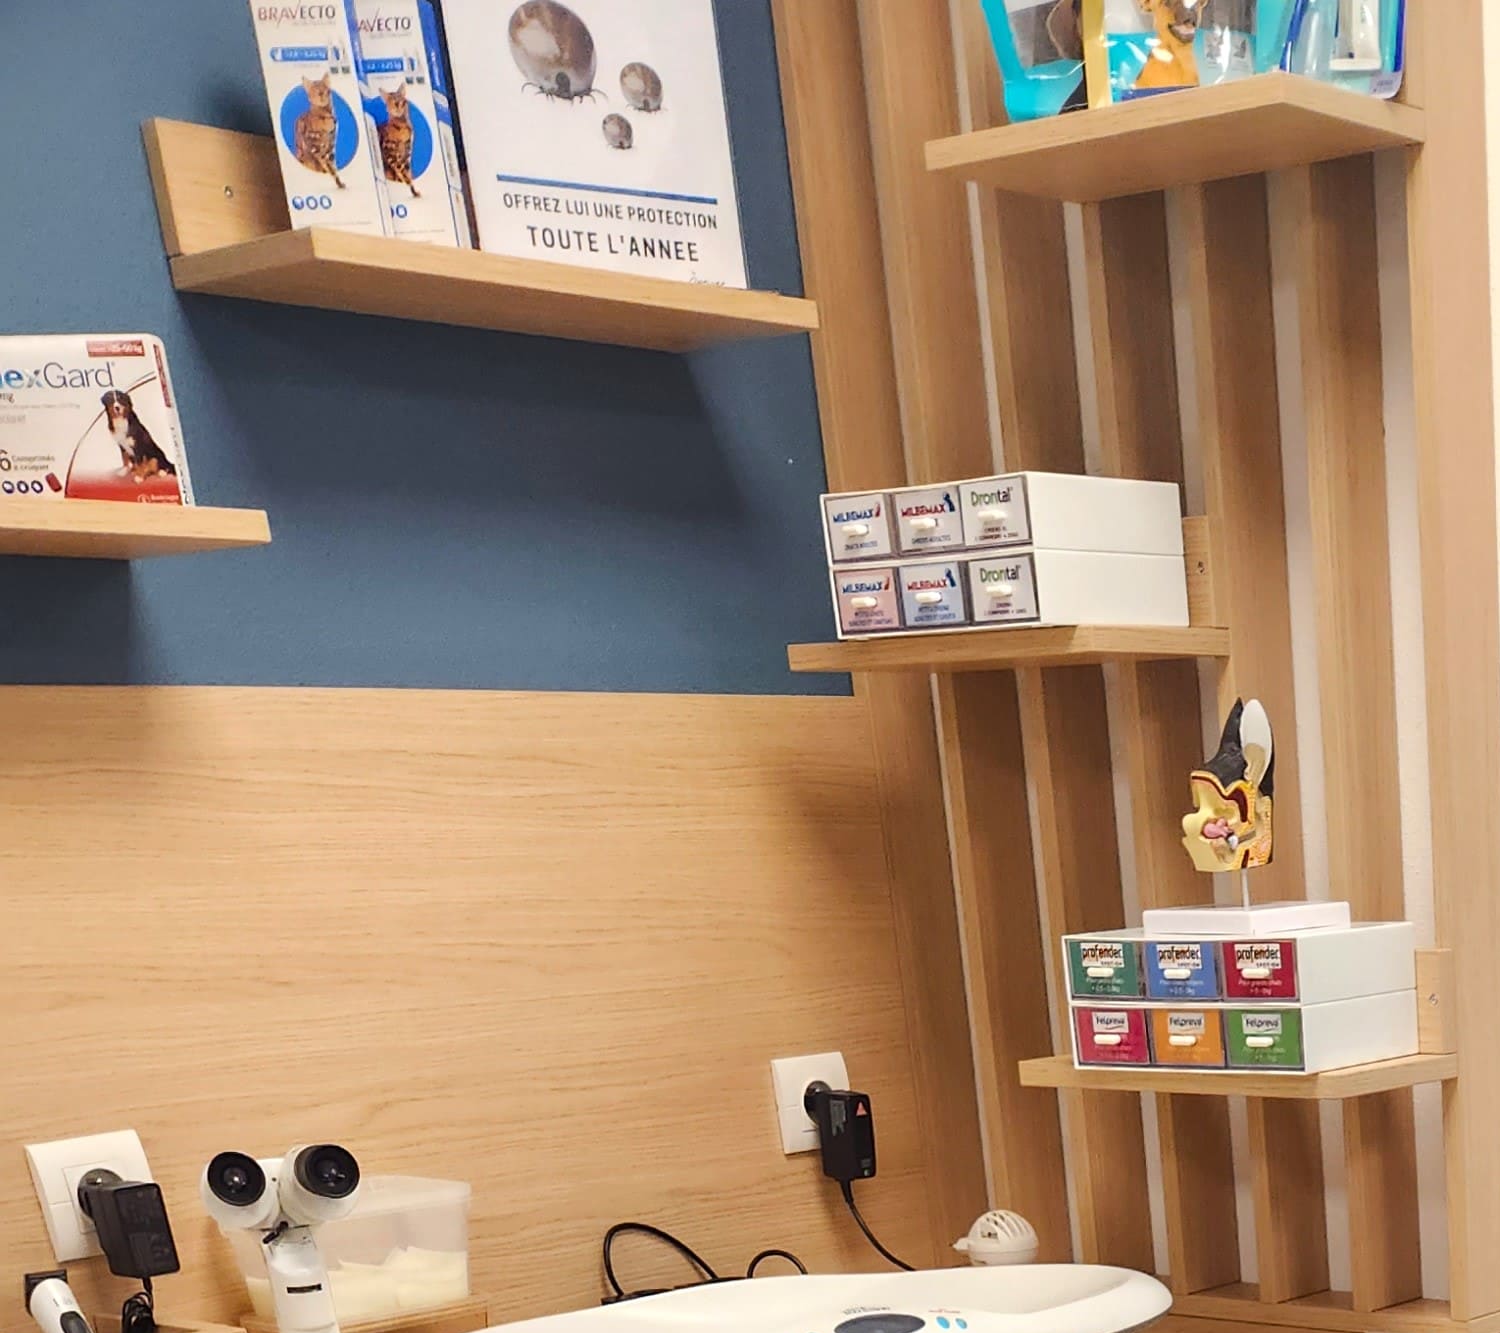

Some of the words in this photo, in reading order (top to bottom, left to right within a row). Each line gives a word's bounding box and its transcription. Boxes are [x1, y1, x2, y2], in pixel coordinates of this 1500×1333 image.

[258, 4, 336, 25] BRAVECTO
[358, 12, 411, 32] AVECTO
[503, 192, 561, 213] OFFREZ
[566, 199, 590, 216] LUI
[594, 203, 623, 220] UNE
[628, 206, 718, 229] PROTECTION
[527, 225, 599, 252] TOUTE
[608, 233, 699, 262] L'ANNEE
[0, 361, 114, 389] exGard
[971, 487, 1011, 507] Drontal
[833, 509, 873, 522] MILBEMAX
[901, 504, 945, 517] MILBEMAX
[980, 565, 1019, 582] Drontal
[842, 581, 882, 593] MILBEMAX
[907, 579, 947, 591] MILBEMAX
[1082, 944, 1122, 961] profender
[1158, 946, 1200, 962] profender
[1236, 945, 1279, 963] profender
